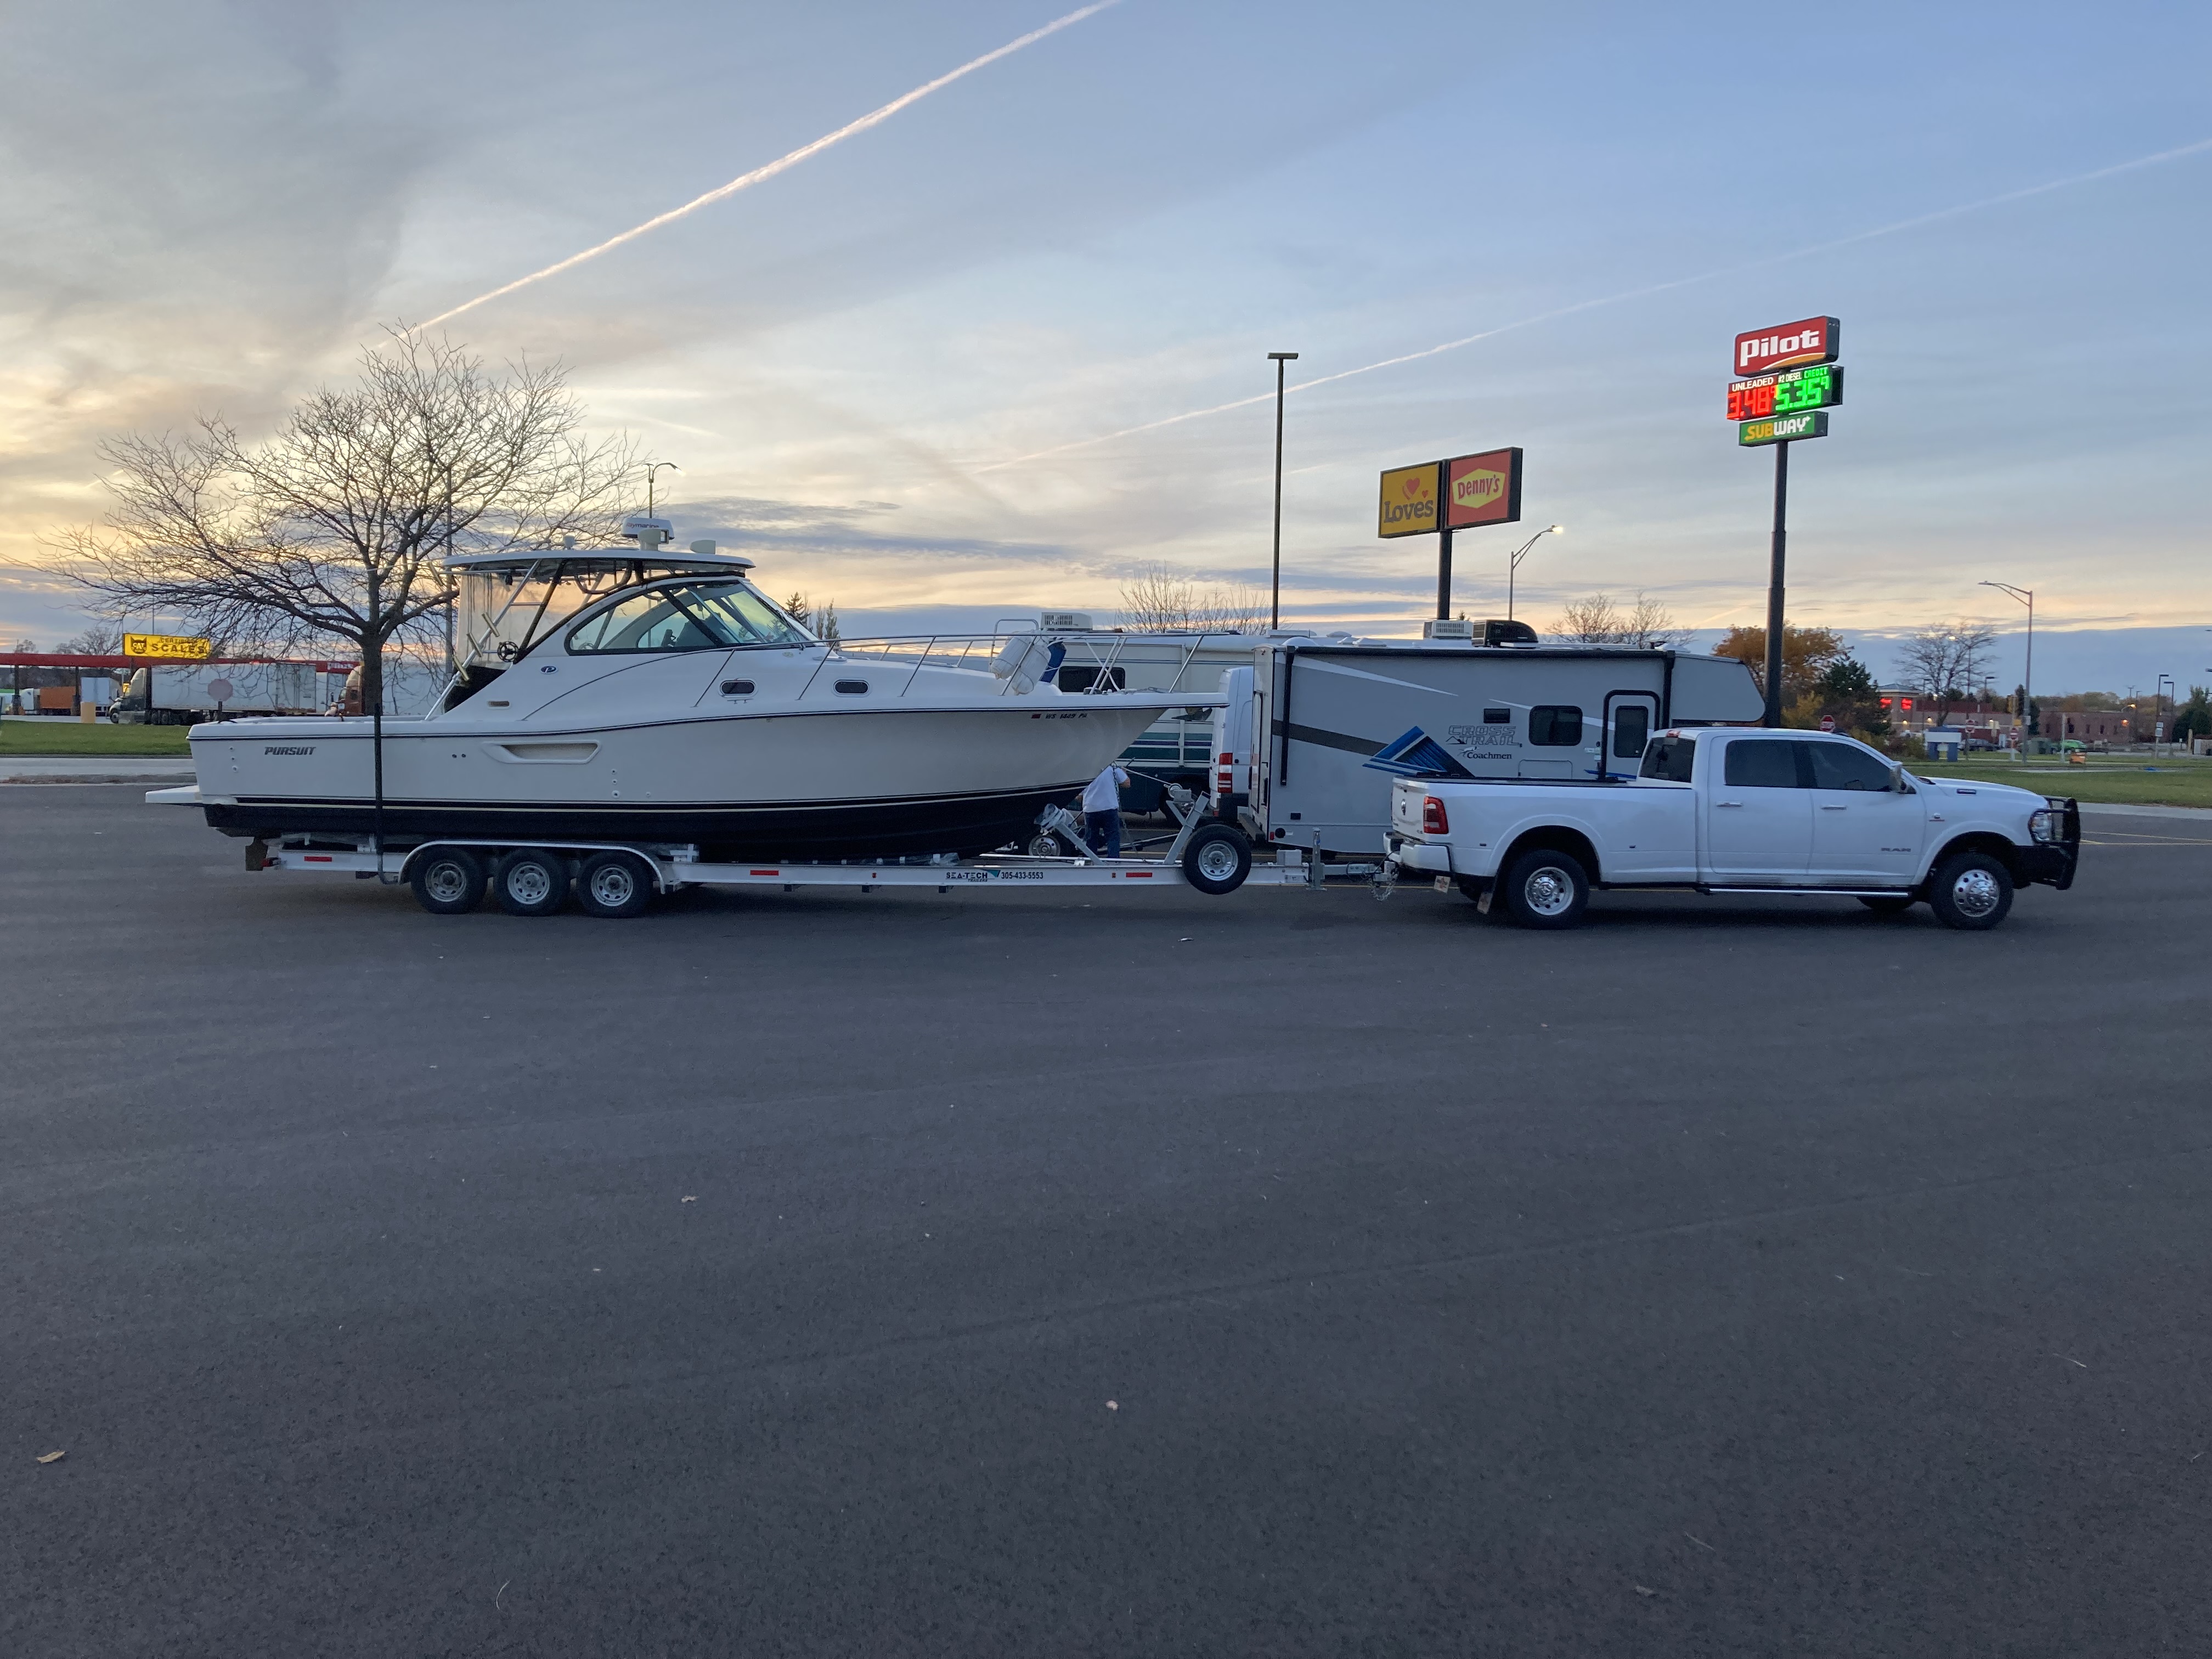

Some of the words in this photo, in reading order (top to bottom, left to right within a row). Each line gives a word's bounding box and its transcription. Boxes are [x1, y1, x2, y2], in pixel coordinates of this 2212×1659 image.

[1740, 330, 1820, 366] Pilot
[1786, 372, 1802, 382] DIESEL
[1804, 367, 1829, 379] CREDIT
[1732, 377, 1774, 392] UNLEADED
[1745, 415, 1811, 441] SUBWAY
[1457, 474, 1500, 500] Denny's
[151, 644, 205, 653] SCALES
[1448, 725, 1516, 736] CROSS
[1459, 735, 1520, 746] TRAIL
[264, 747, 316, 755] PURSUIT
[1001, 871, 1043, 879] 305-433-5553
